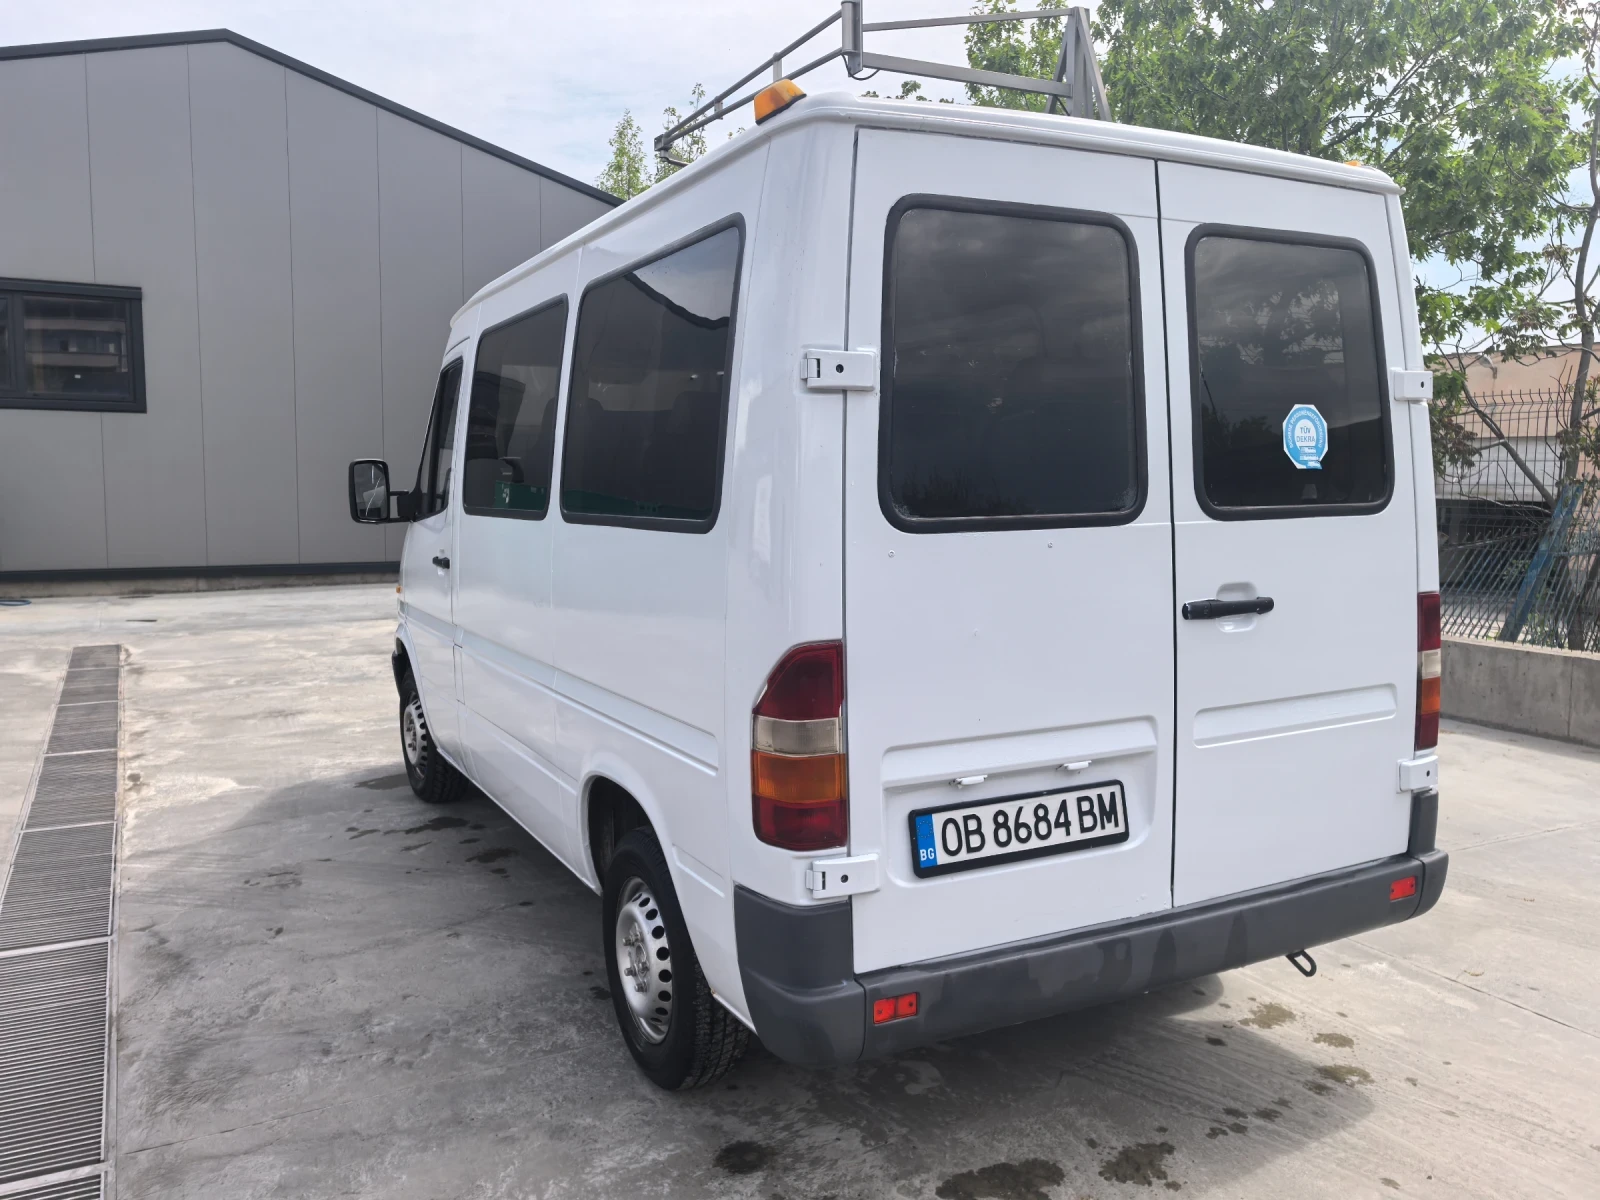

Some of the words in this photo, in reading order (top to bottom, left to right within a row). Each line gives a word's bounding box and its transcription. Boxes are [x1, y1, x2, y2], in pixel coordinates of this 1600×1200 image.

[1296, 435, 1316, 443] DEKRA
[941, 813, 985, 857] OB
[993, 799, 1071, 848] 8684
[1076, 791, 1119, 834] BM
[920, 848, 935, 861] BG
